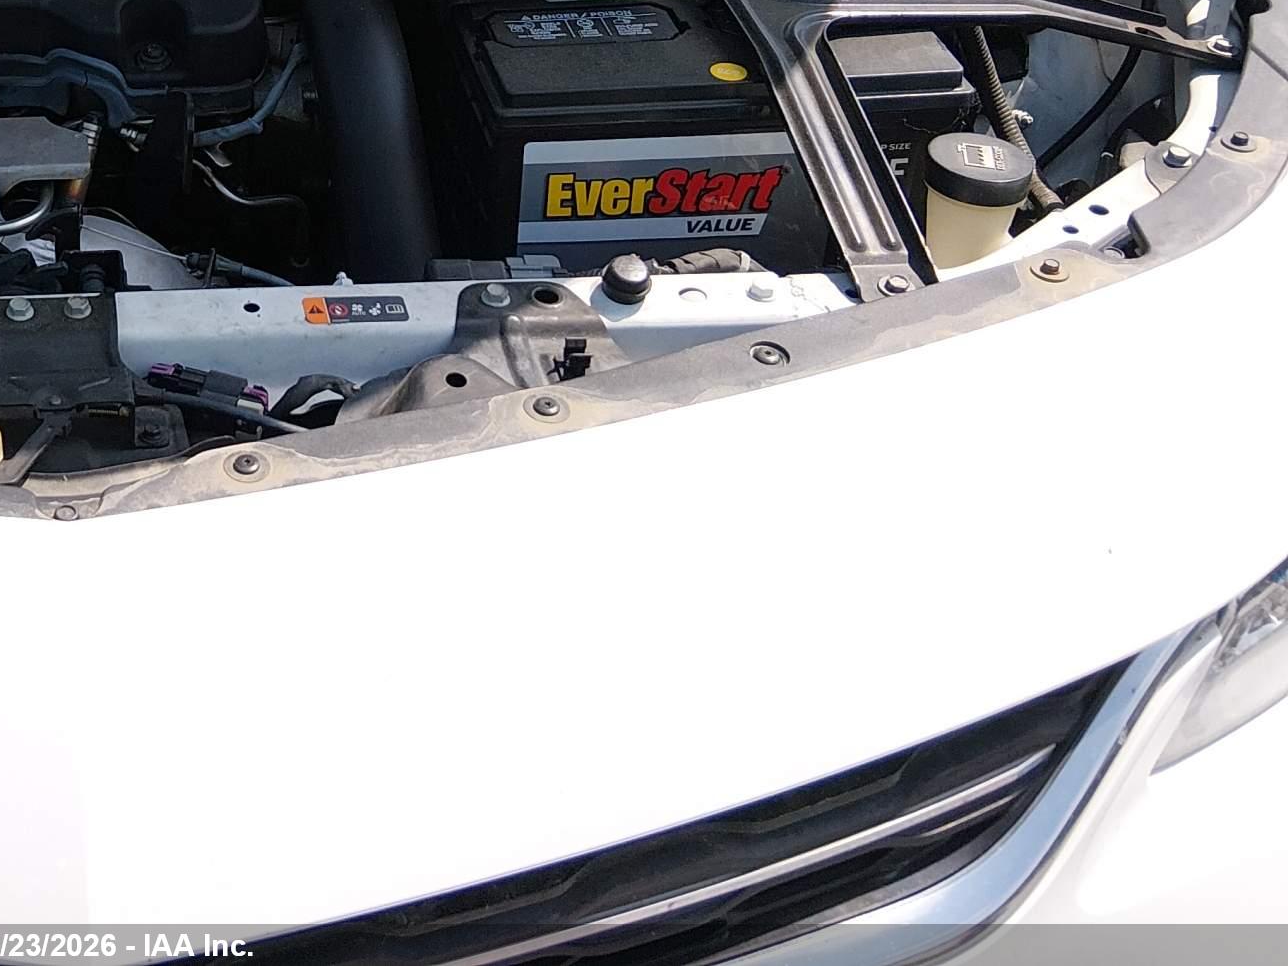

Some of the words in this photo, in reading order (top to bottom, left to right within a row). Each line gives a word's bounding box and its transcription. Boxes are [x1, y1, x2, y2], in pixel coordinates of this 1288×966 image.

[533, 11, 580, 20] DANGER
[590, 9, 633, 18] POISON
[888, 142, 912, 151] SIZE
[545, 166, 783, 218] EverStart
[687, 218, 756, 234] VALUE
